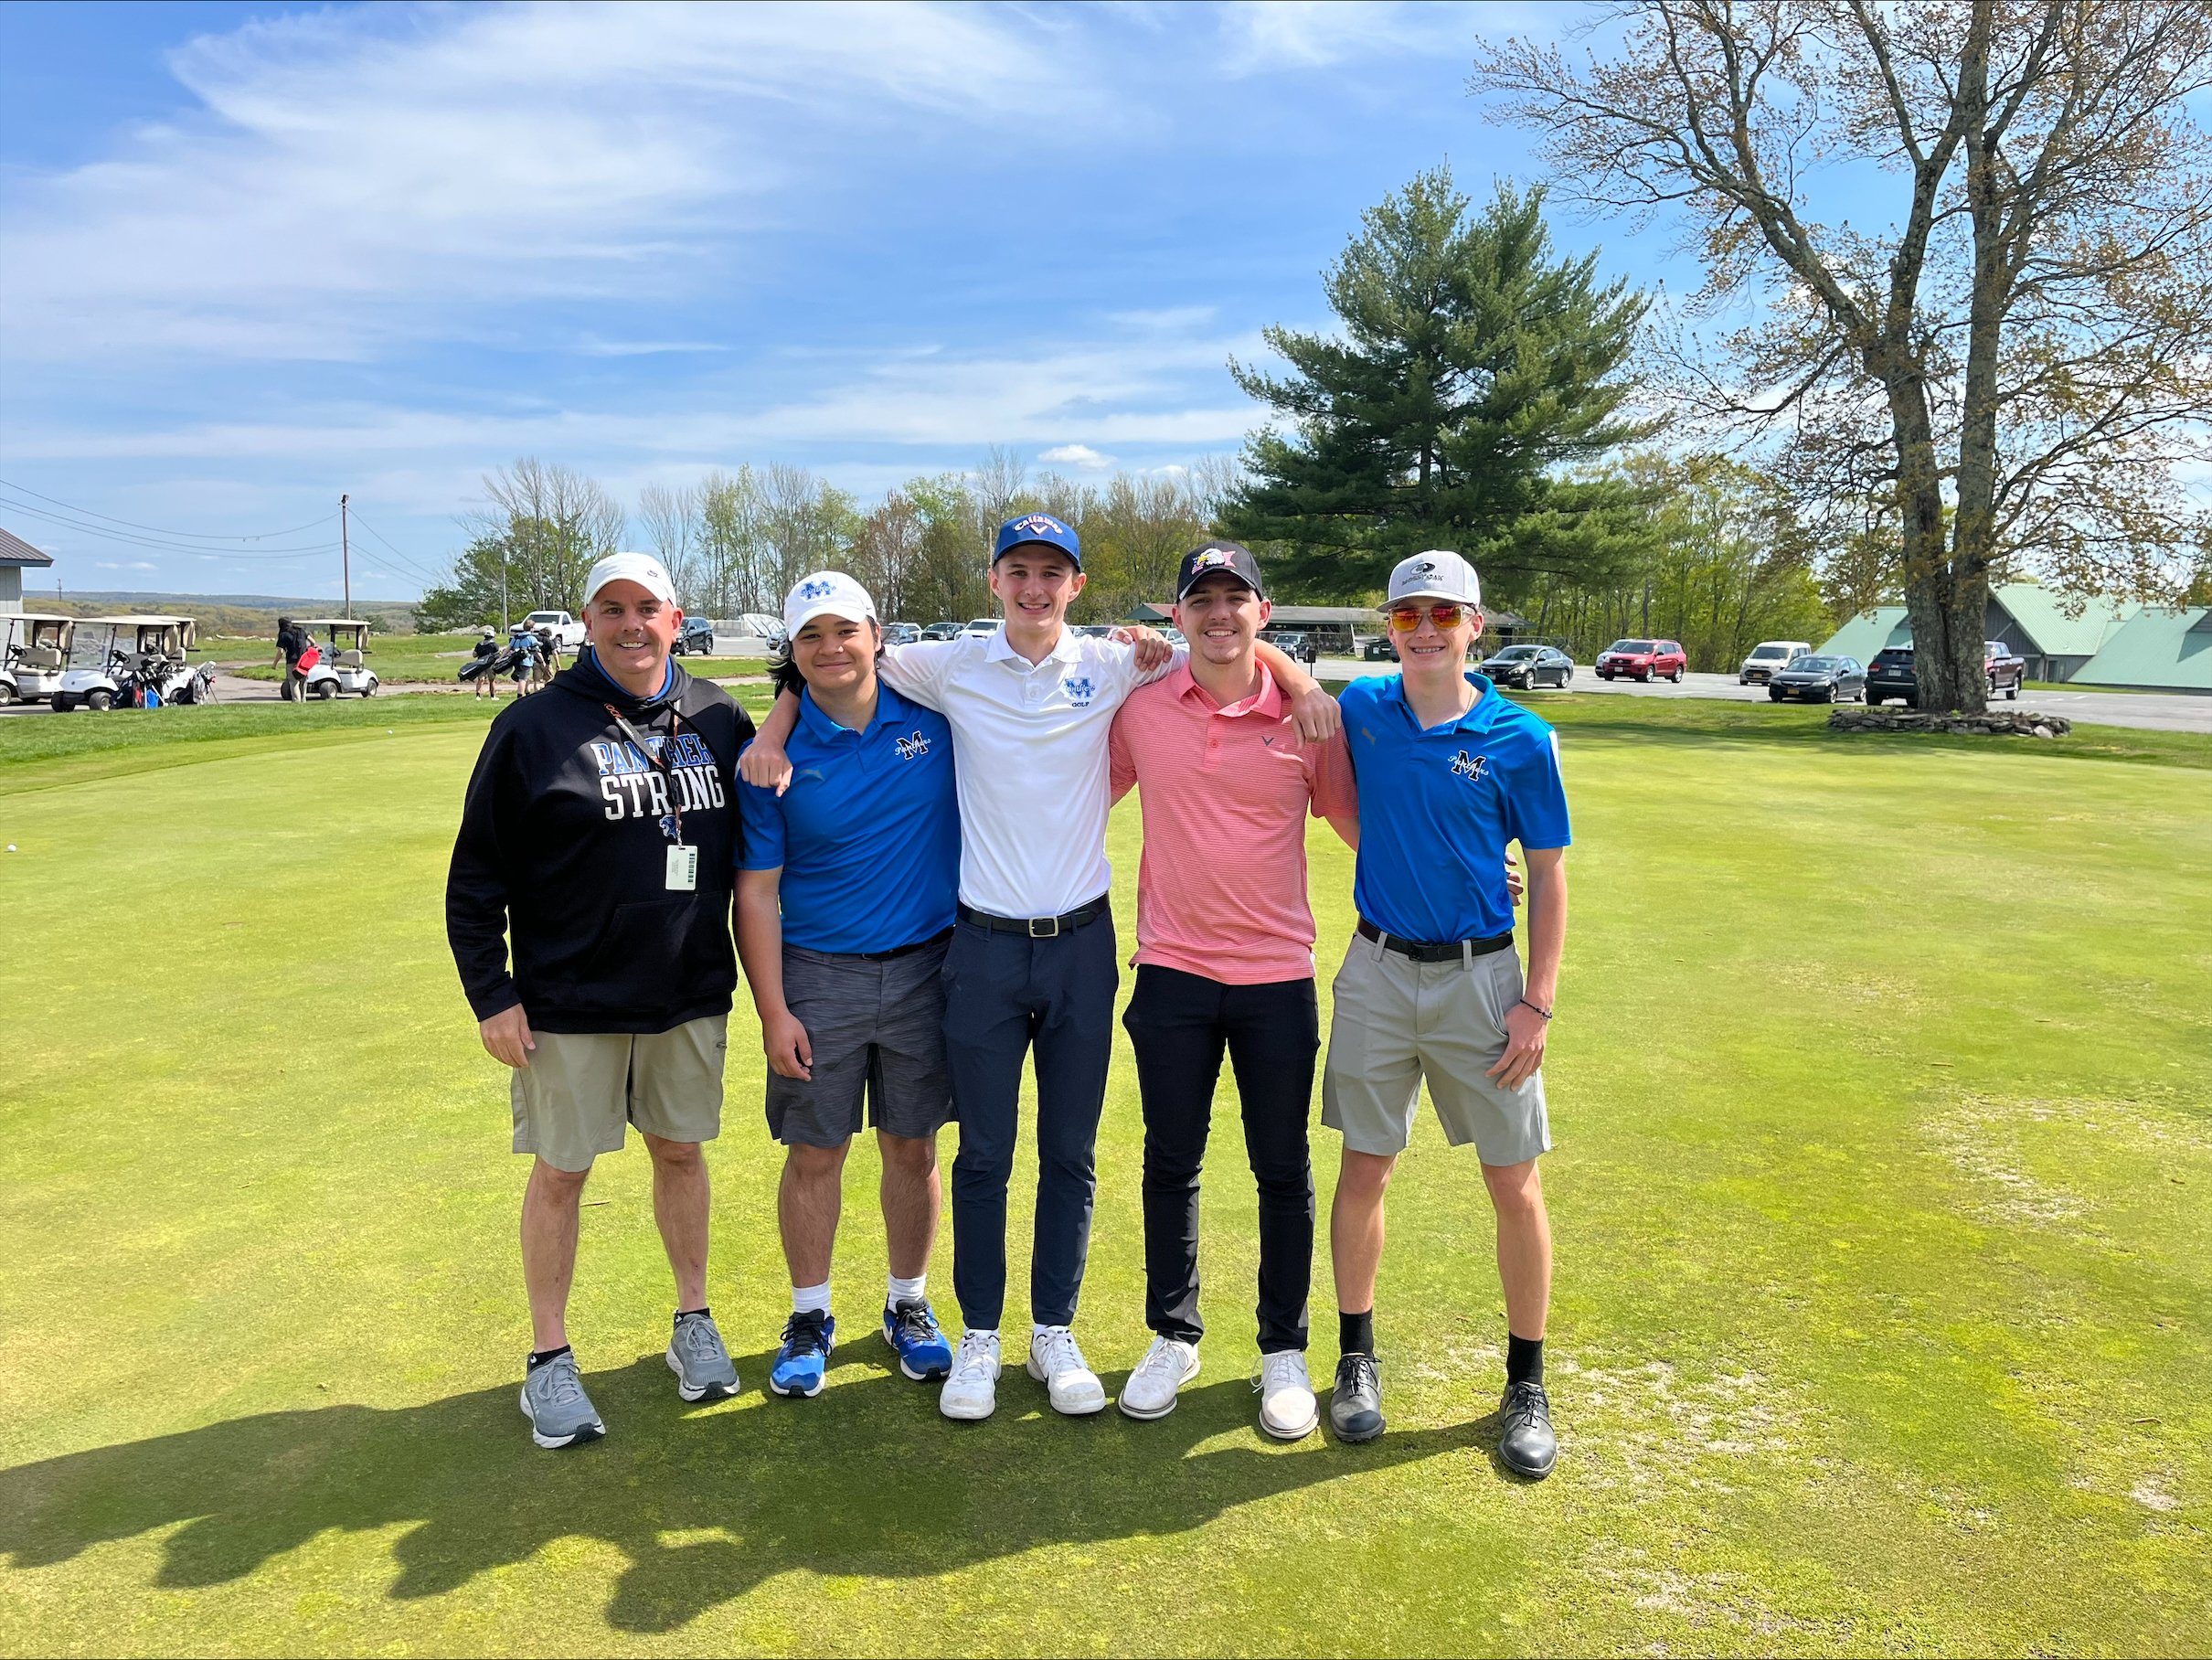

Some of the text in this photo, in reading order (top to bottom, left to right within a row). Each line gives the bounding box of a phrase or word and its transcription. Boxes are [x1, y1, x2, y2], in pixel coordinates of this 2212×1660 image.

[1014, 515, 1063, 534] Callaway
[895, 729, 929, 761] M
[1450, 749, 1487, 782] M
[600, 764, 726, 820] STRONG
